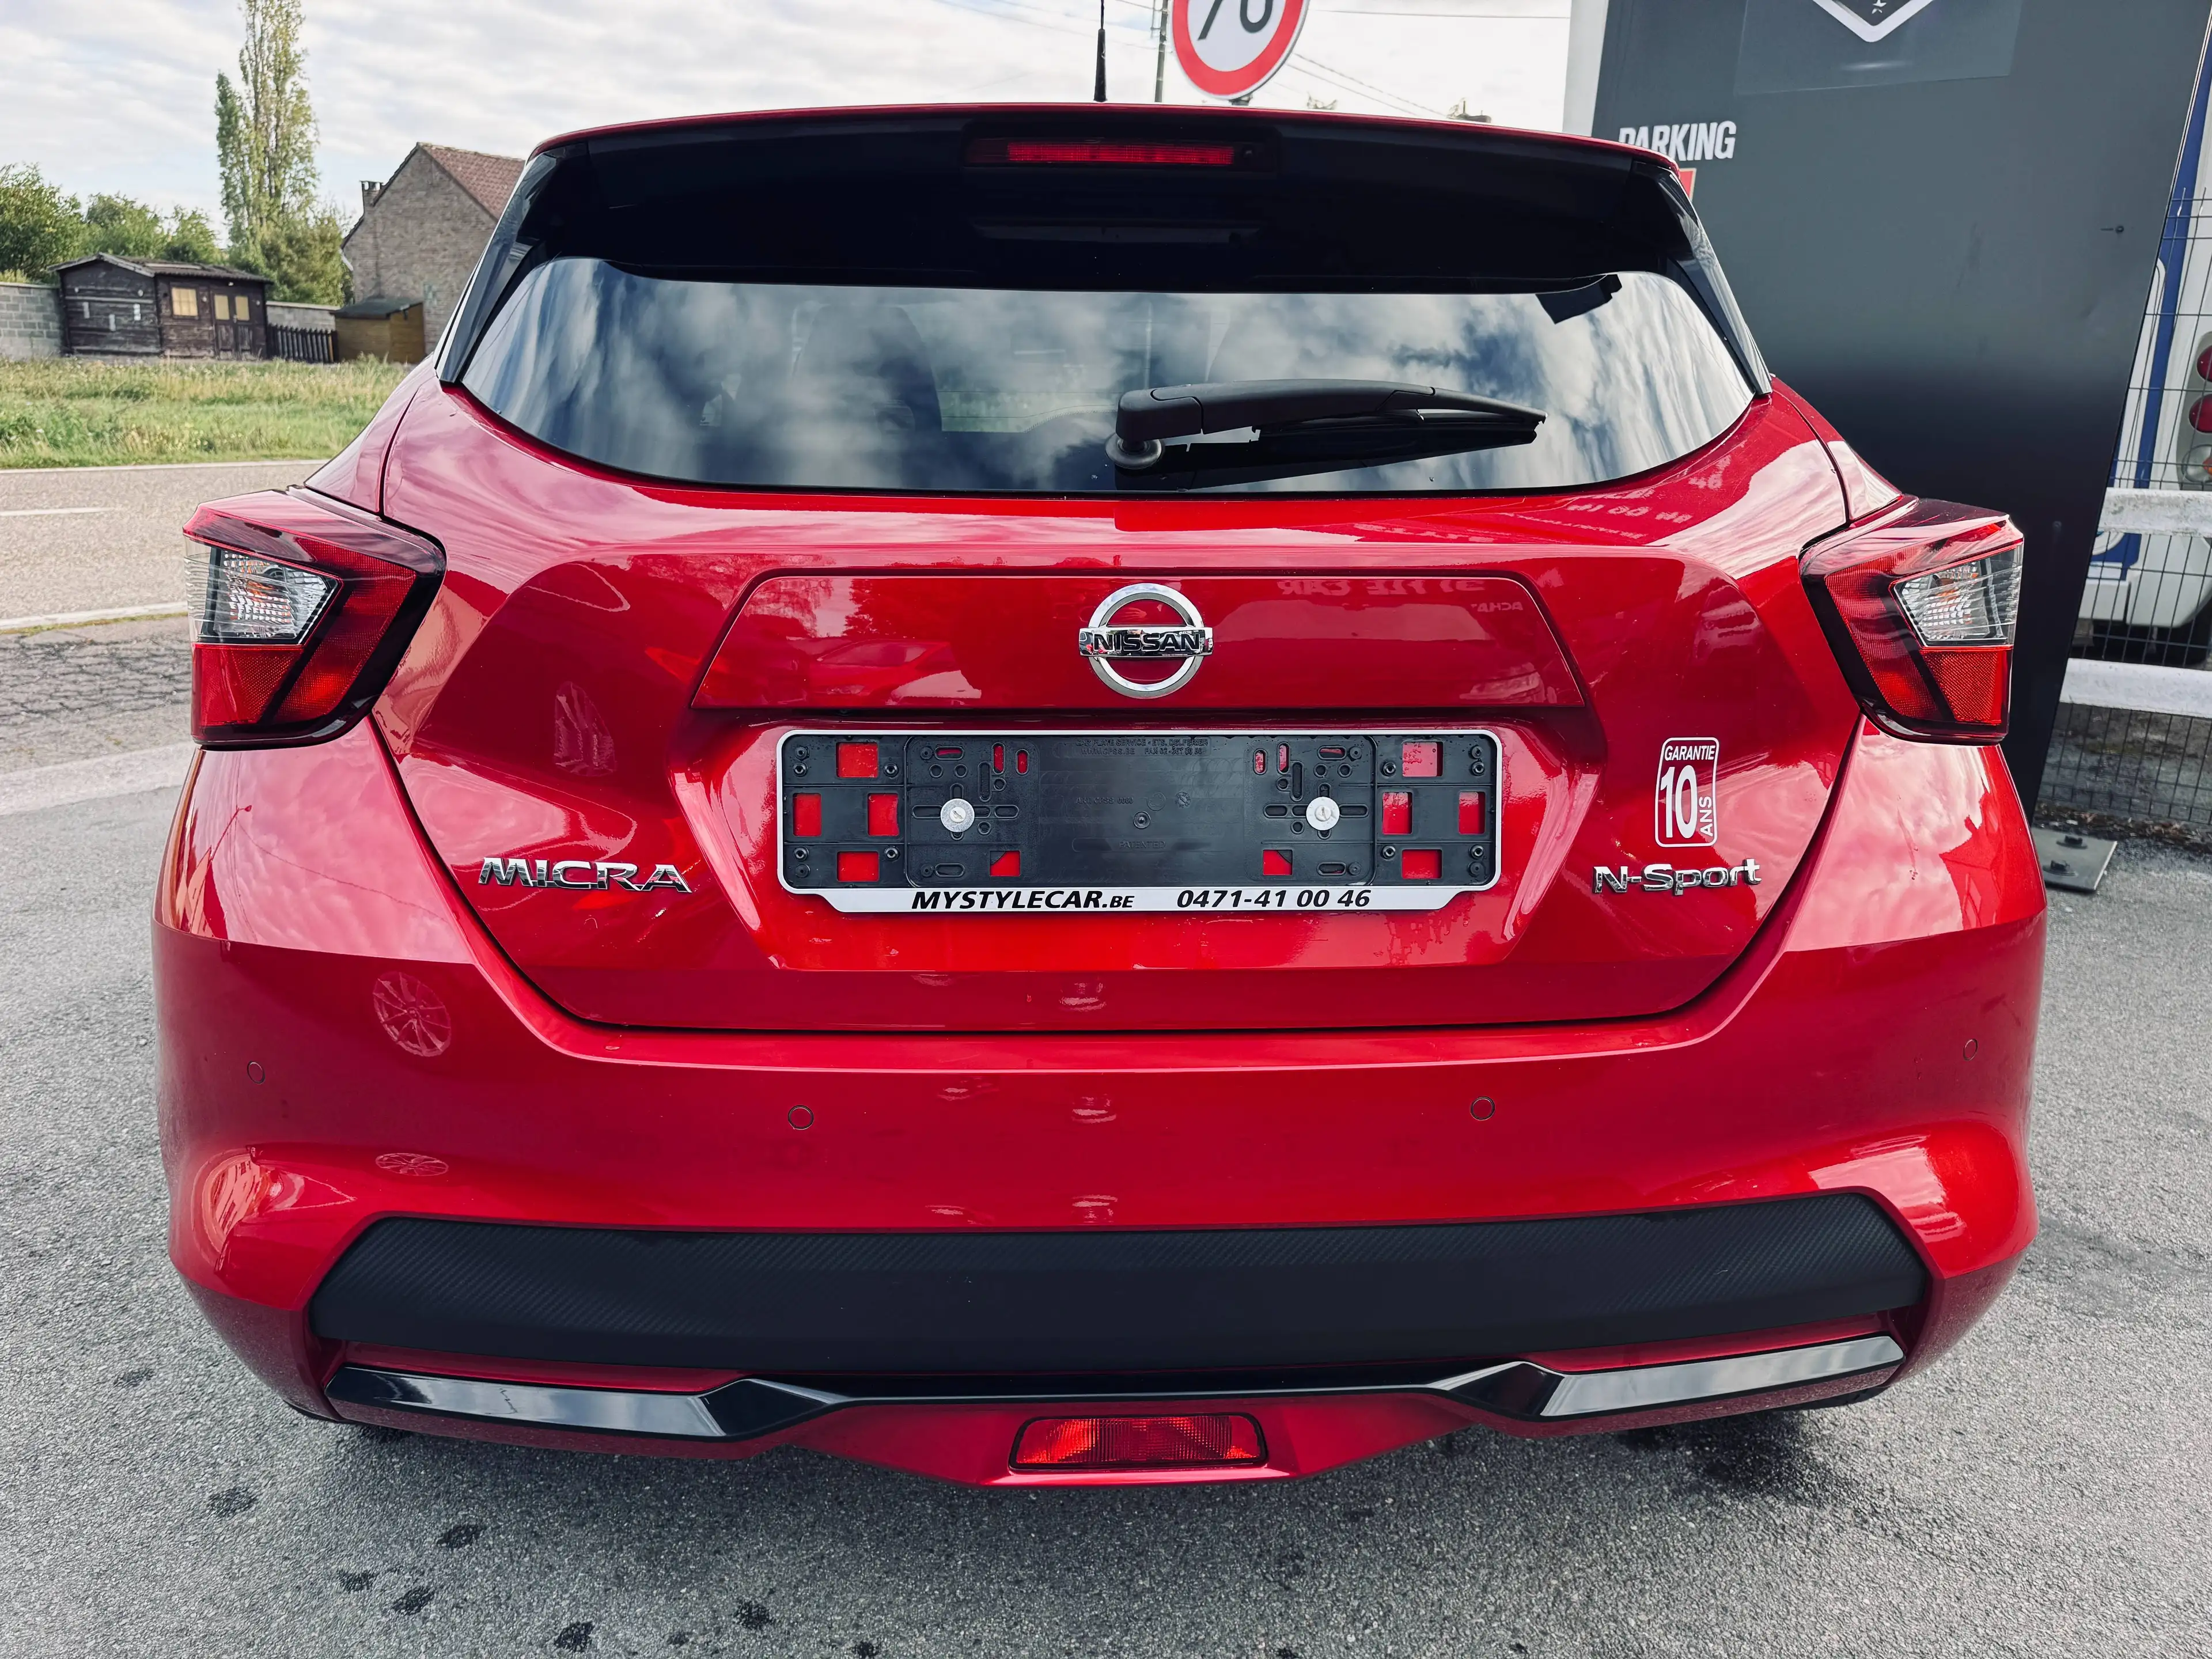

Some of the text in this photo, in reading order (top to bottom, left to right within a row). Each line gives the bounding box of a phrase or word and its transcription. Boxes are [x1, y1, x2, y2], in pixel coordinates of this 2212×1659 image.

[1094, 633, 1200, 652] NISSAN
[1664, 745, 1715, 762] GARANTIE
[1660, 764, 1698, 839] 10
[1698, 796, 1714, 837] ANS
[1119, 840, 1166, 849] PATENTED
[478, 857, 692, 893] MICRA
[1592, 858, 1762, 896] N-Sport
[911, 889, 1372, 910] MYSTYLECAR.BE 0471-41 00 46
